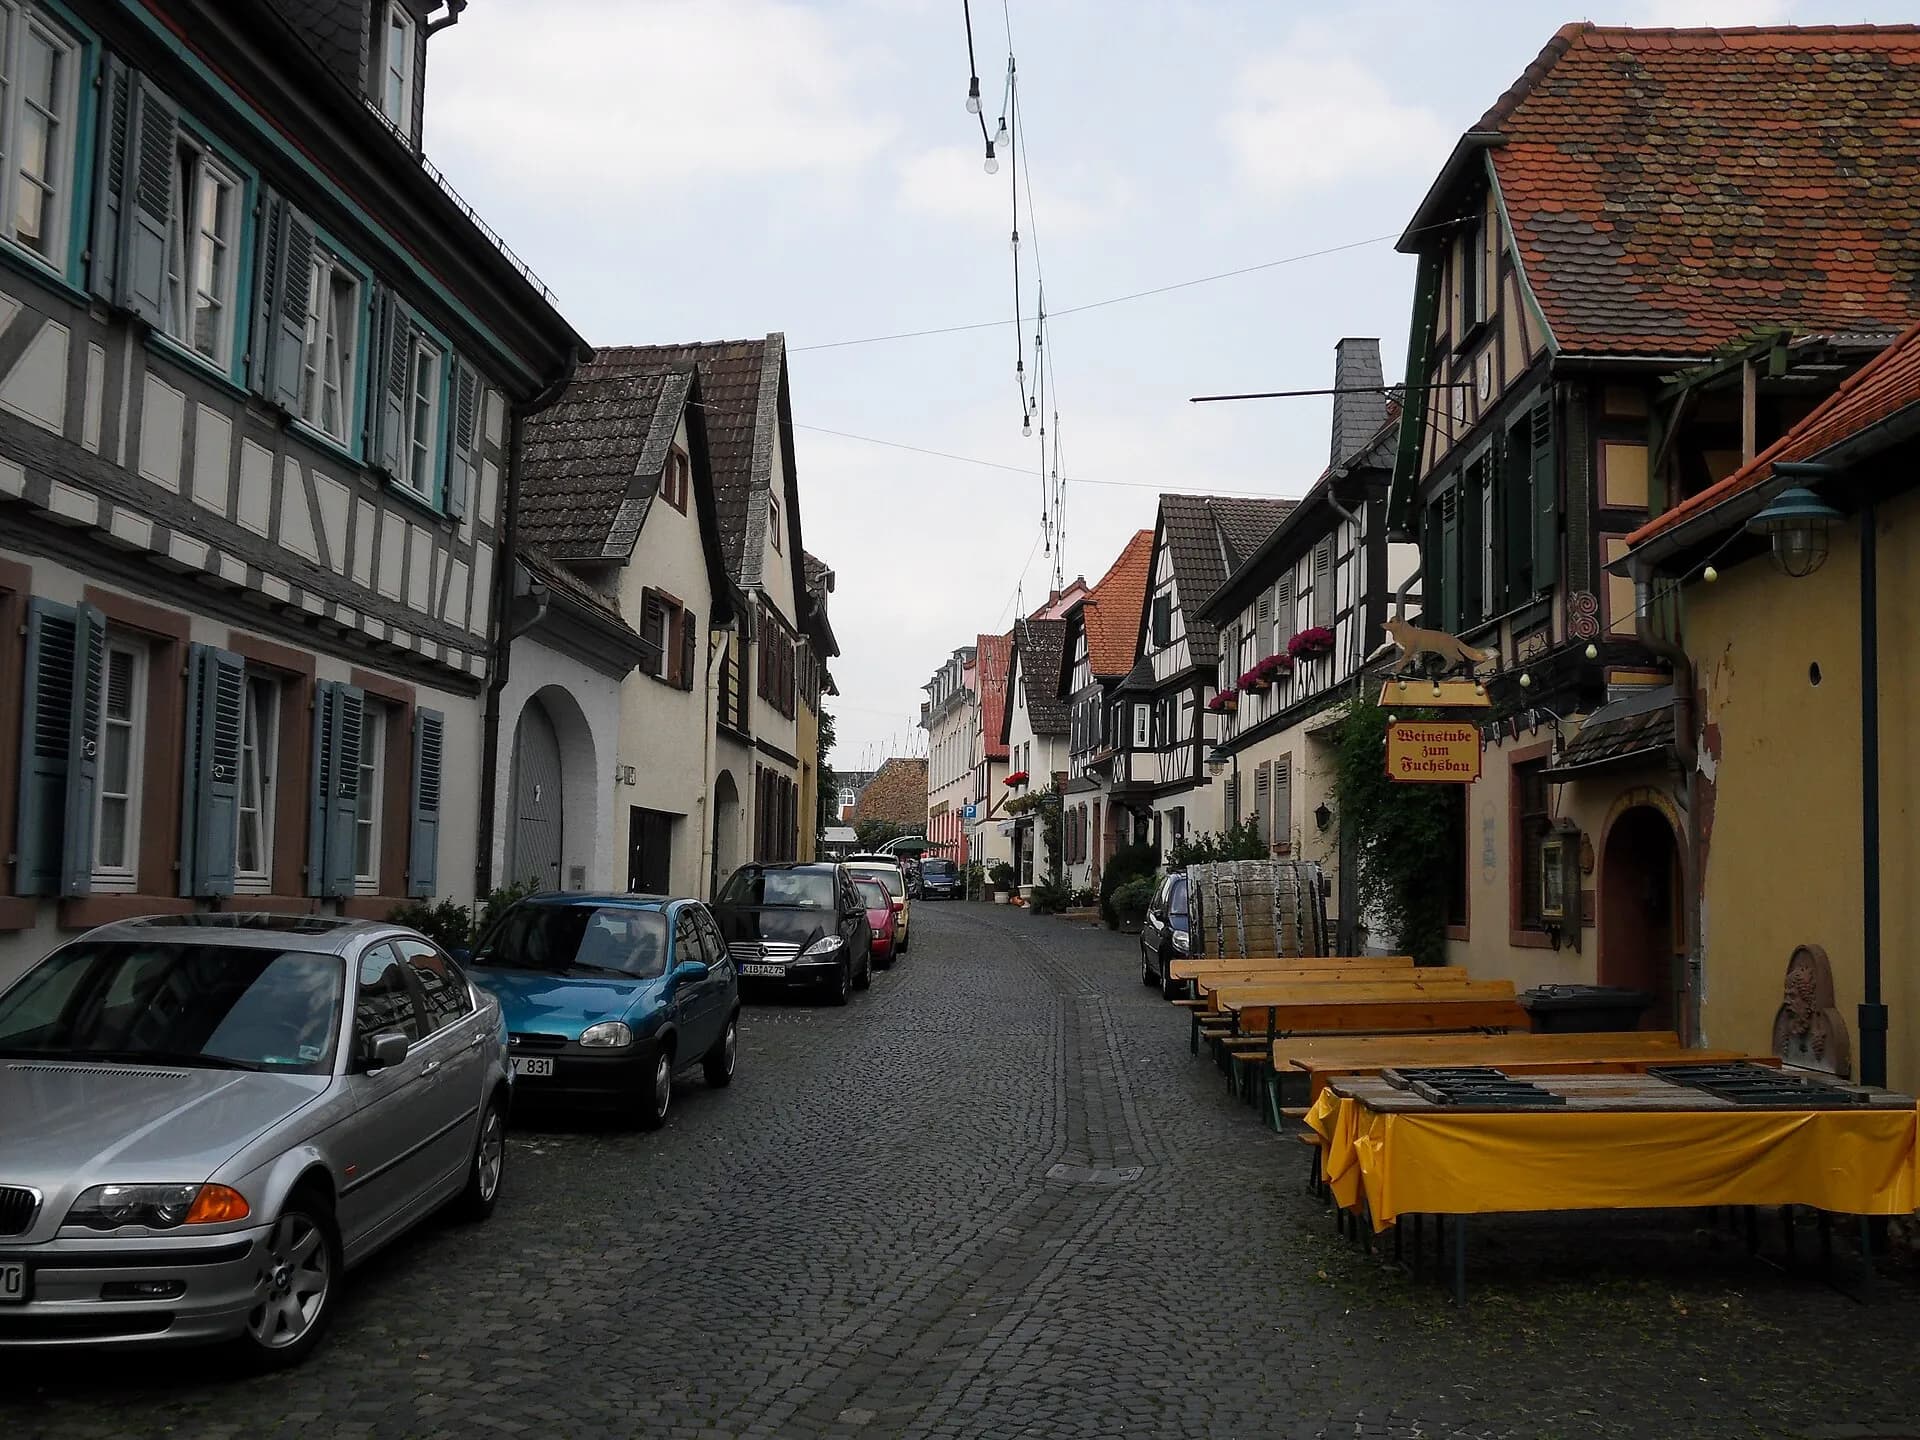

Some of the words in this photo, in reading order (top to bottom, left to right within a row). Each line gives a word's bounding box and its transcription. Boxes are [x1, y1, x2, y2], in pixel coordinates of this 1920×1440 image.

[1399, 730, 1472, 743] Weinstube
[1421, 745, 1449, 757] zum
[1400, 756, 1470, 774] Fuchsbau
[966, 806, 974, 817] P
[527, 1059, 550, 1075] 831
